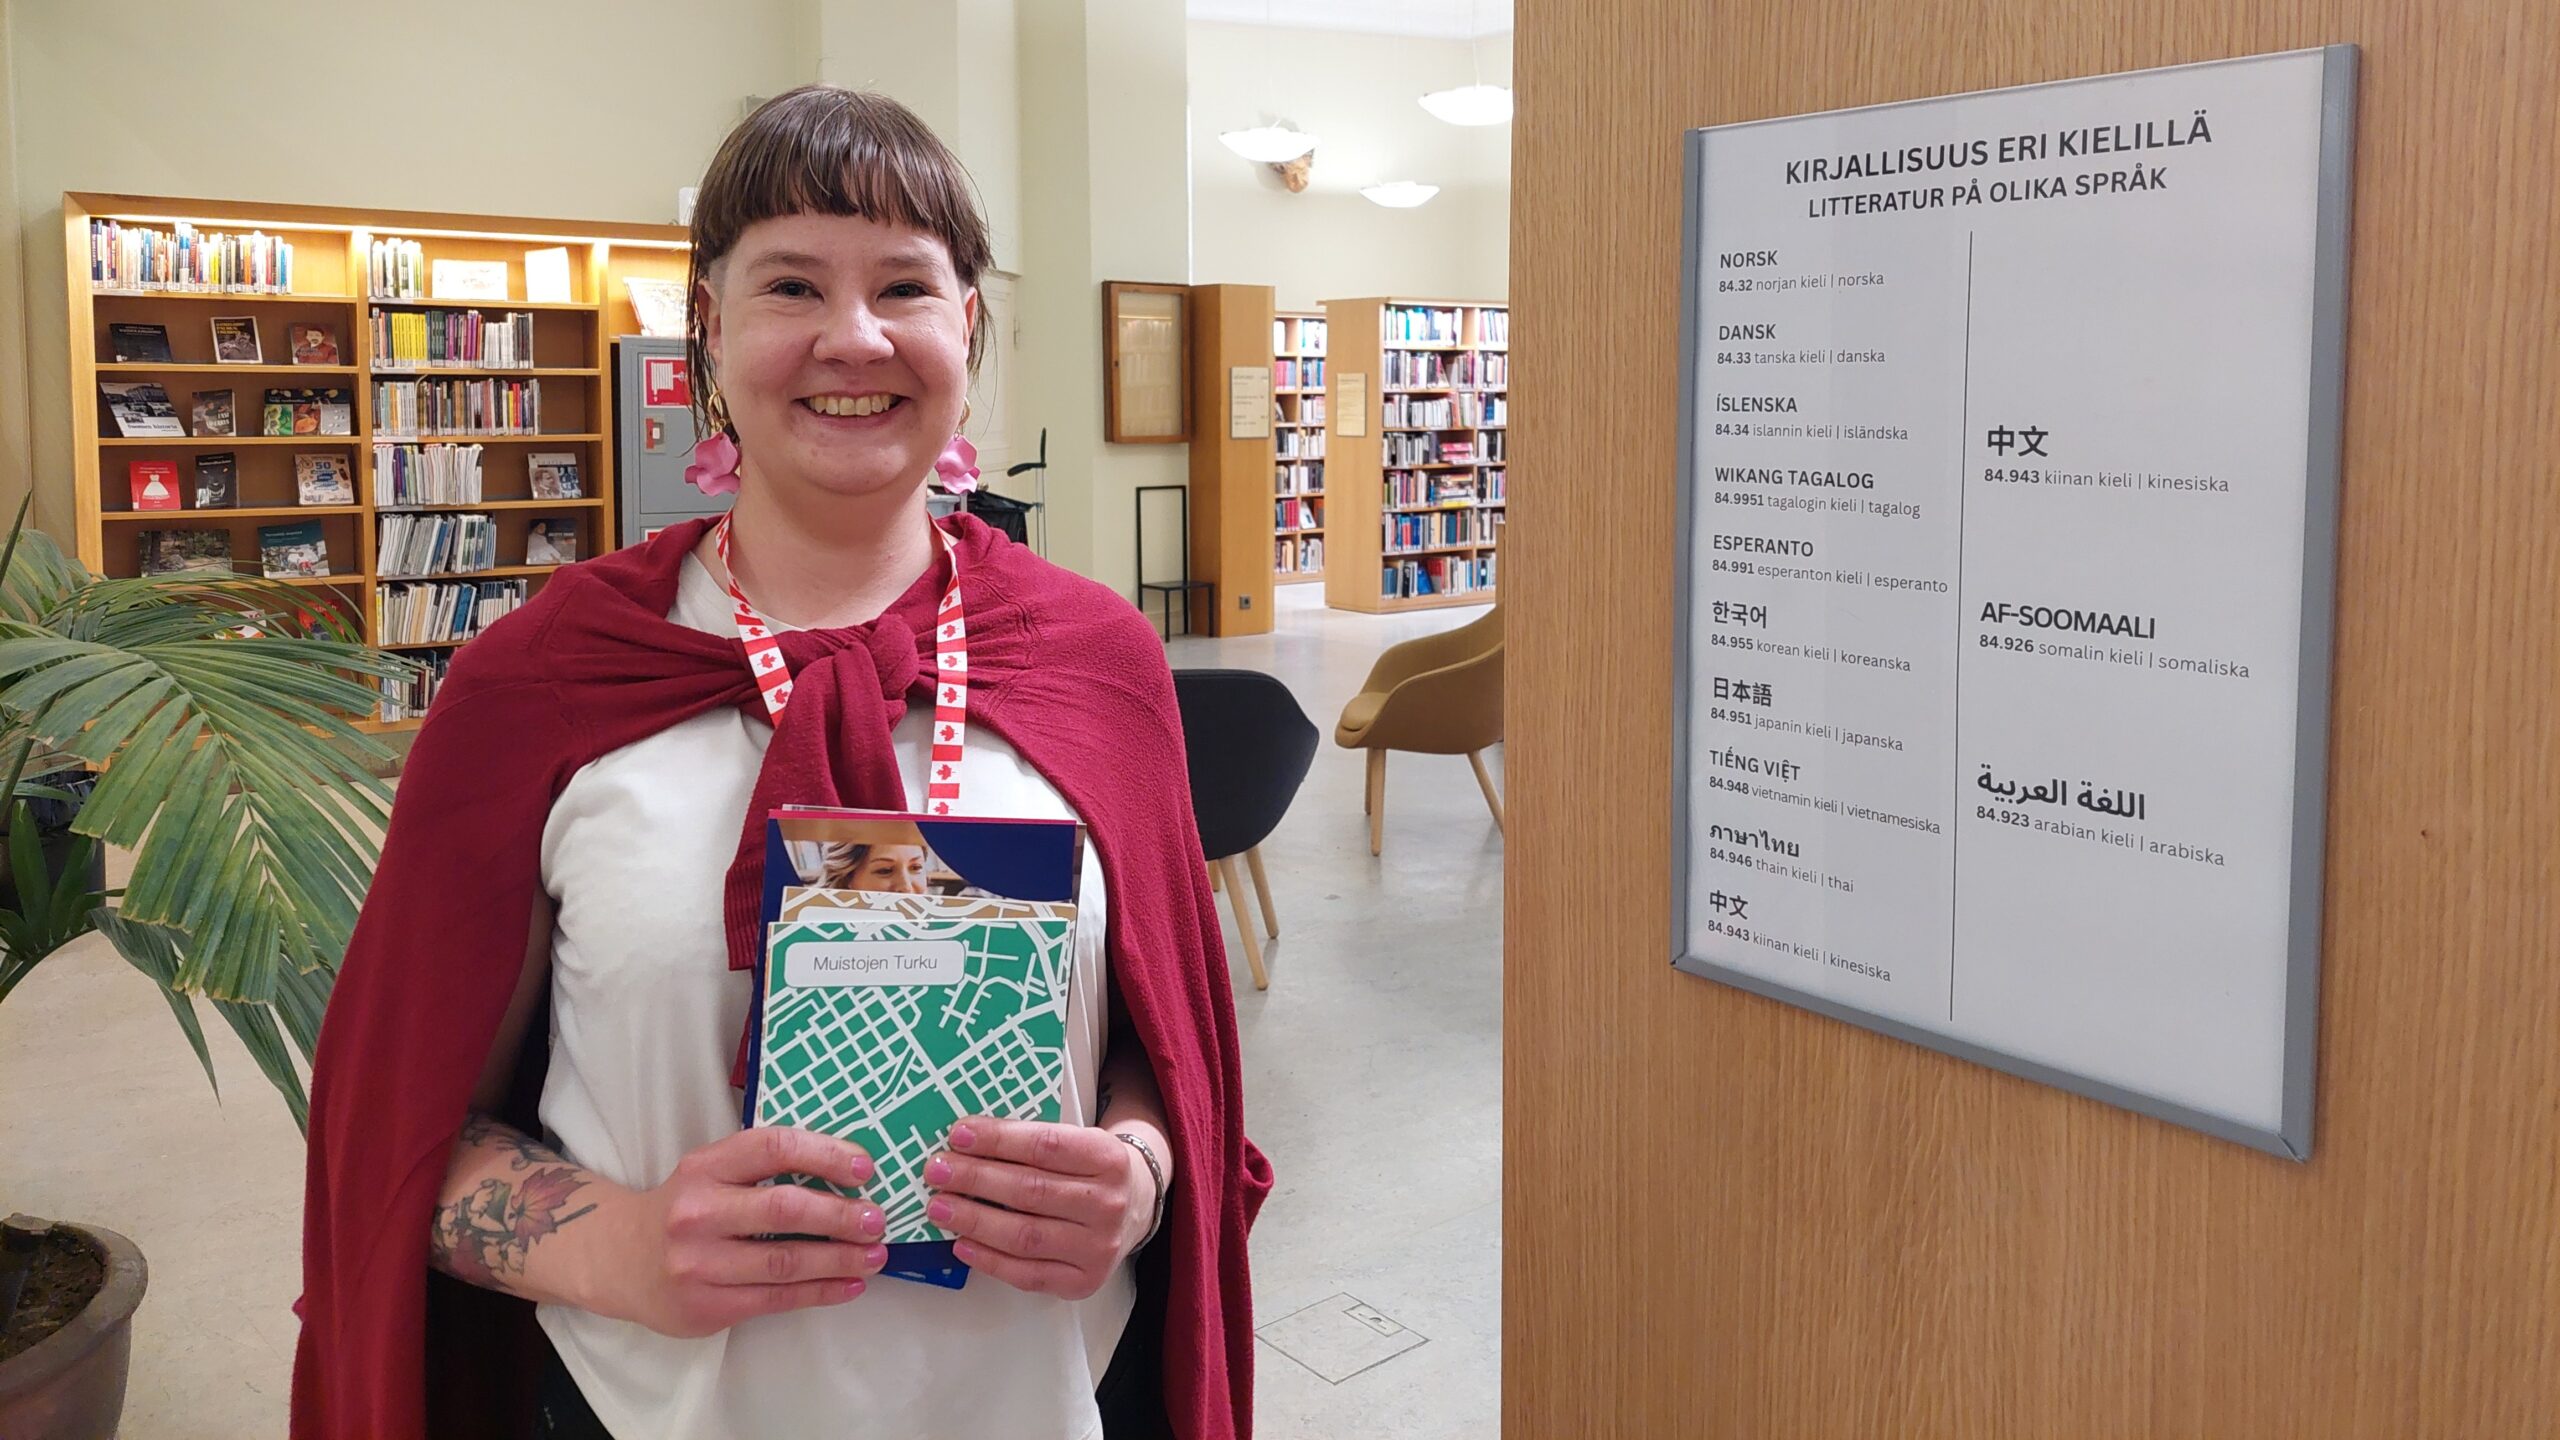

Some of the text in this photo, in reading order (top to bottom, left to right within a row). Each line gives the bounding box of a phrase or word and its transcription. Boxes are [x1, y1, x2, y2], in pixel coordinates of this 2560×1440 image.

[1787, 110, 2211, 184] KIRJALLISUUS ERI KIELILLÄ
[1810, 163, 2167, 217] LITTERATUR PÅ OLIKA SPRÅK
[1721, 250, 1777, 268] NORSK
[1719, 279, 1752, 292] 84.32
[1757, 278, 1796, 293] norjan
[1801, 275, 1826, 288] kieli
[1839, 272, 1884, 286] norska
[1720, 324, 1776, 340] DANSK
[1718, 352, 1751, 364] 84.33
[1755, 351, 1795, 363] tanska
[1800, 350, 1825, 363] kieli
[1837, 349, 1885, 362] danska
[1717, 394, 1797, 412] ÍSLENSKA
[1716, 424, 1749, 435] 84.34
[1753, 424, 1802, 437] islannin
[1807, 425, 1832, 438] kieli
[1844, 425, 1908, 440] isländska
[1988, 425, 2048, 457] 中文
[1715, 467, 1873, 489] WIKANG TAGALOG
[1985, 469, 2039, 483] 84.943
[2045, 470, 2092, 485] kiinan
[2099, 472, 2131, 487] kieli
[2148, 474, 2228, 492] kinesiska
[1715, 492, 1764, 506] 84.9951
[1768, 496, 1826, 512] tagalogin
[1831, 498, 1856, 511] kieli
[1869, 502, 1920, 519] tagalog
[1714, 535, 1813, 556] ESPERANTO
[1713, 560, 1754, 574] 84.991
[1758, 566, 1831, 581] esperanton
[1836, 570, 1862, 584] kieli
[1875, 577, 1947, 592] esperanto
[1712, 601, 1766, 629] 한국어
[1980, 602, 2155, 639] AF-SOOMAALI
[1712, 634, 1753, 650] 84.955
[1757, 639, 1799, 656] korean
[1804, 645, 1829, 660] kieli
[1842, 650, 1910, 671] koreanska
[1980, 635, 2034, 652] 84.926
[2039, 644, 2103, 661] somalin
[2110, 648, 2143, 665] kieli
[2159, 657, 2249, 678] somaliska
[1714, 677, 1772, 707] 日本語
[1711, 707, 1751, 725] 84.951
[1754, 715, 1801, 733] japanin
[1806, 723, 1831, 738] kieli
[1841, 729, 1903, 751] japanska
[1710, 747, 1800, 782] TIẾNG VIỆT
[1710, 776, 1749, 794] 84.948
[1752, 787, 1810, 807] vietnamin
[1814, 797, 1837, 812] kieli
[1847, 805, 1940, 834] vietnamesiska
[1978, 764, 2144, 820] اللغة العربية
[1710, 825, 1799, 860] ภาษาไทย
[1977, 806, 2029, 827] 84.923
[2035, 820, 2095, 840] arabian
[2102, 829, 2133, 848] kieli
[2150, 842, 2224, 866] arabiska
[1710, 847, 1752, 867] 84.946
[1756, 859, 1787, 876] thain
[1792, 866, 1816, 883] kieli
[1828, 876, 1853, 892] thai
[1710, 890, 1748, 920] 中文
[813, 955, 938, 973] Muistojen Turku
[1708, 920, 1749, 941] 84.943
[1753, 931, 1789, 952] kiinan
[1794, 943, 1818, 960] kieli
[1831, 953, 1890, 981] kinesiska
